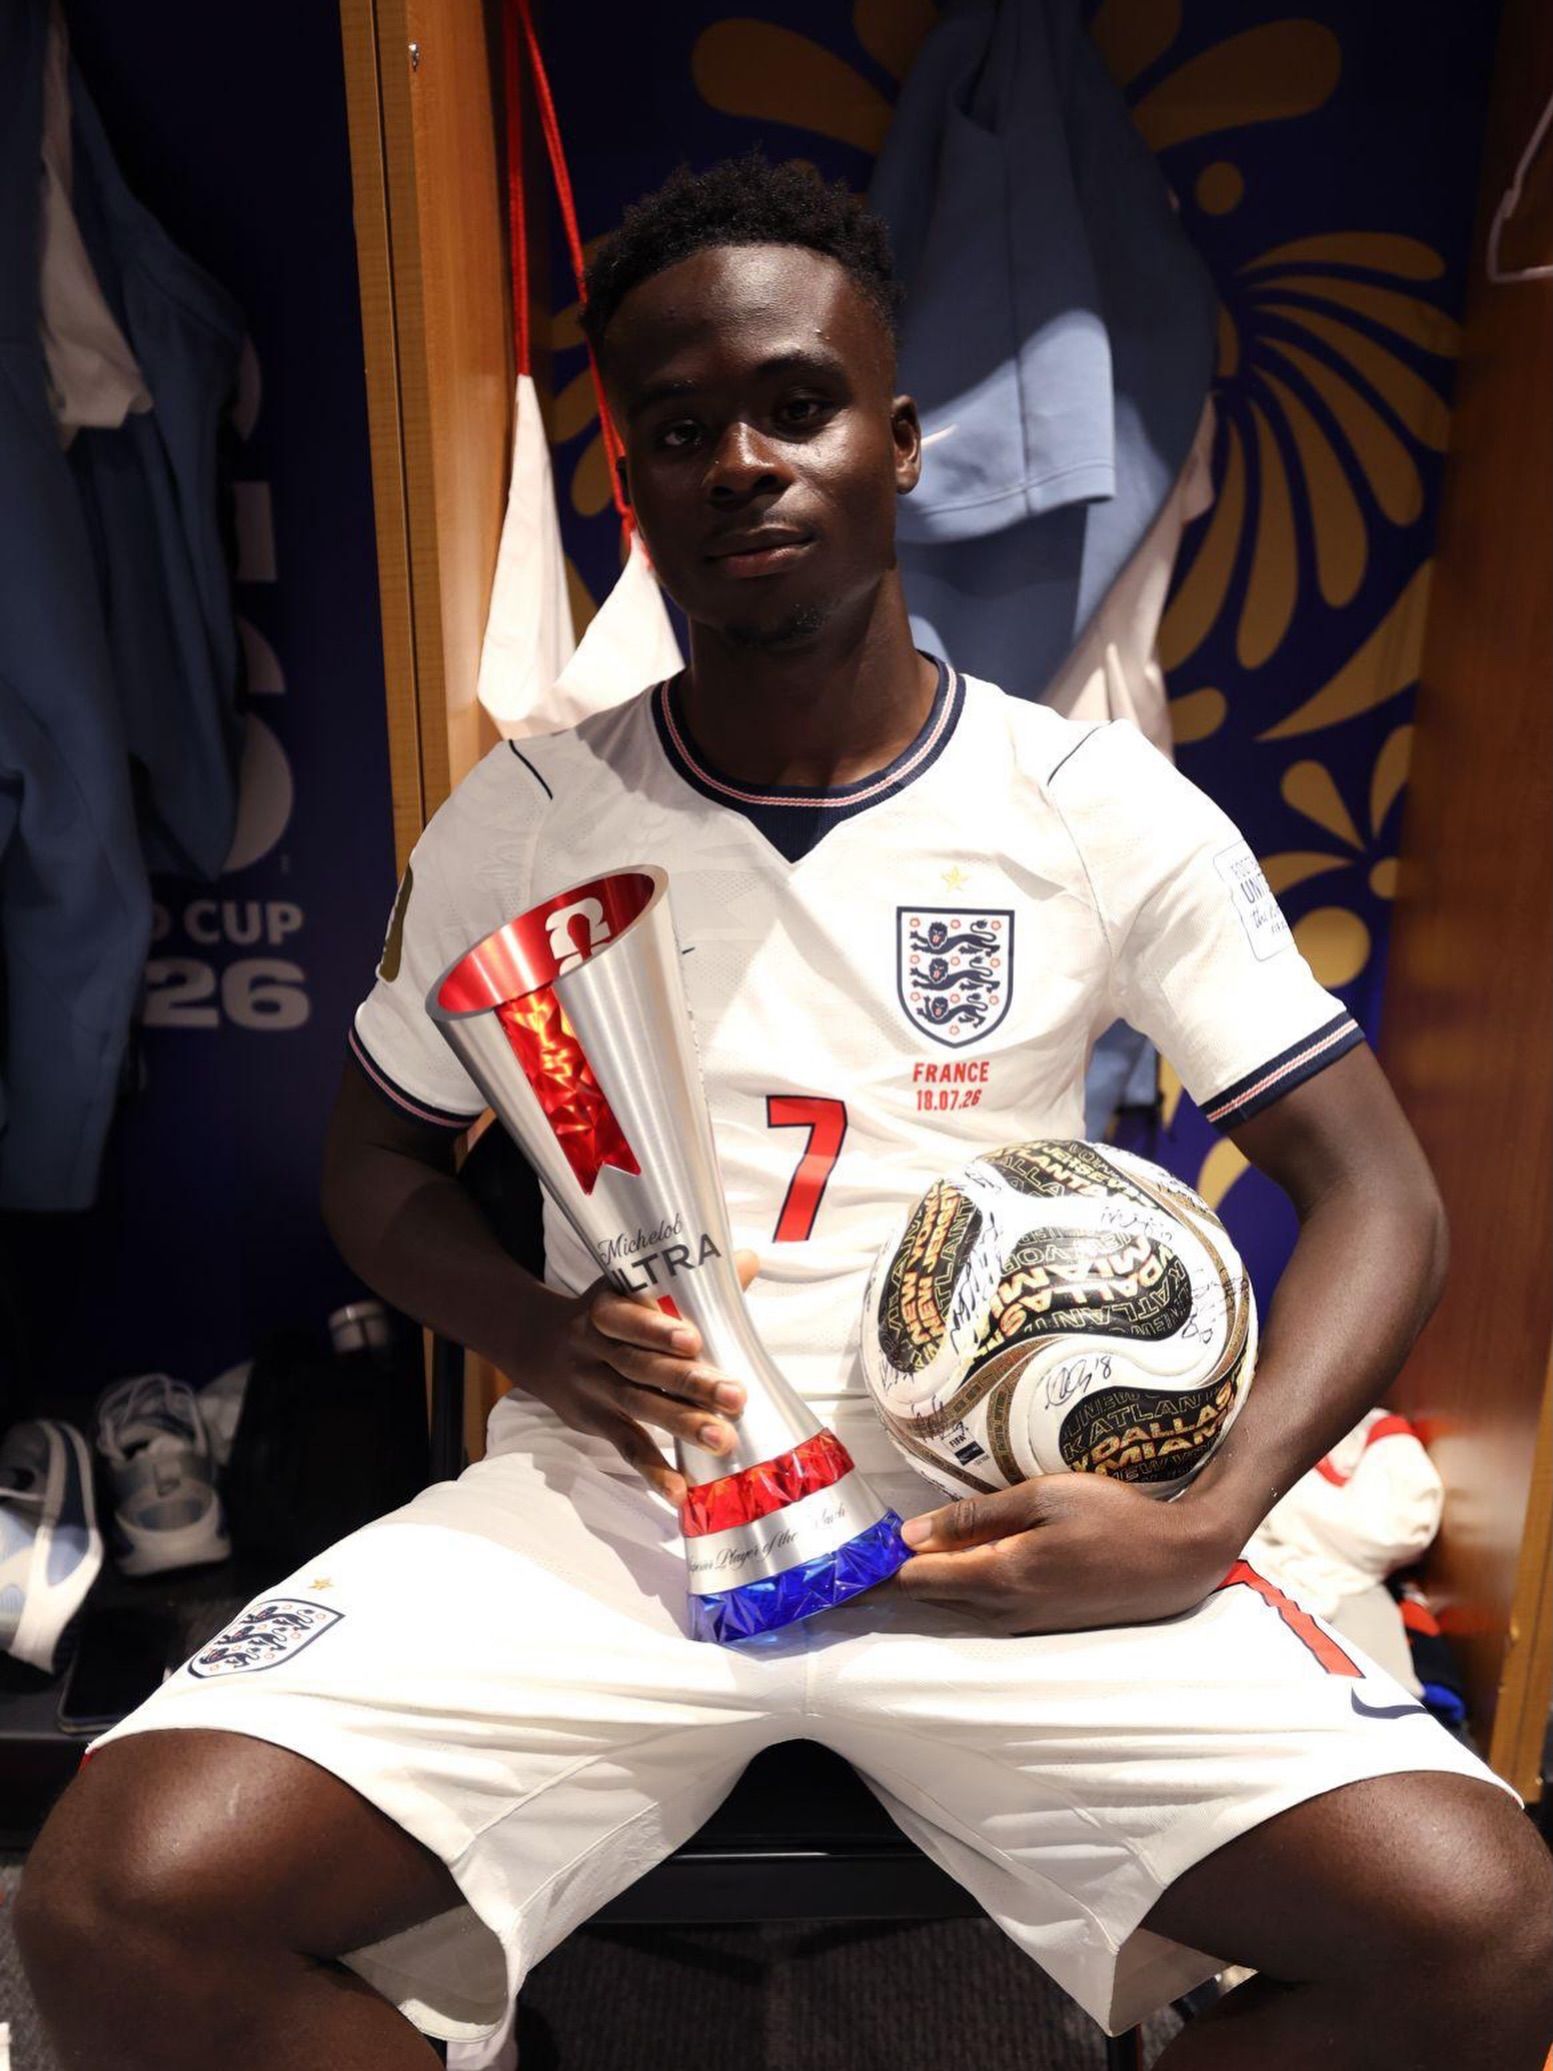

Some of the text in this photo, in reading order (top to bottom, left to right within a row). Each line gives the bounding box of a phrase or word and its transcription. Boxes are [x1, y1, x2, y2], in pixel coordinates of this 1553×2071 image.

[184, 900, 304, 945] CUP
[144, 958, 310, 1031] 26
[913, 1061, 990, 1083] FRANCE
[917, 1089, 983, 1111] 18.07.26
[766, 1094, 848, 1243] 7
[598, 1213, 684, 1266] Michelob
